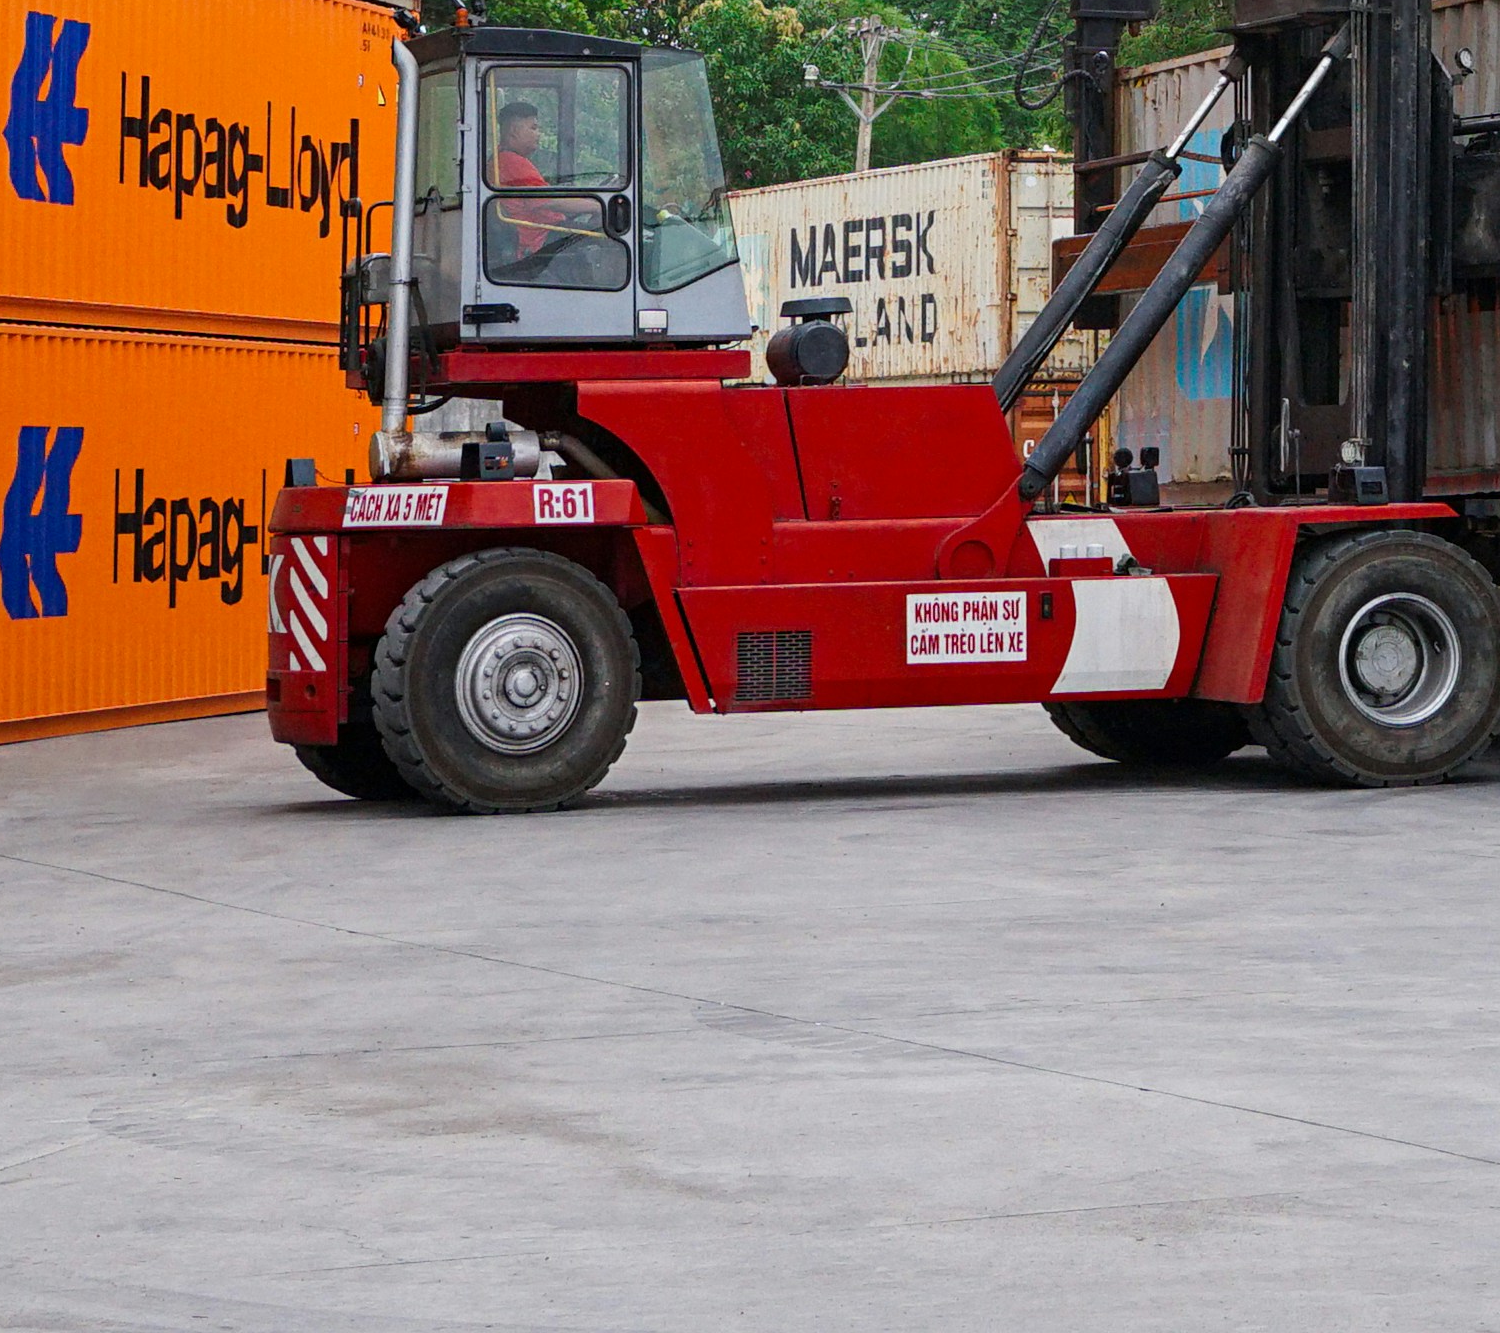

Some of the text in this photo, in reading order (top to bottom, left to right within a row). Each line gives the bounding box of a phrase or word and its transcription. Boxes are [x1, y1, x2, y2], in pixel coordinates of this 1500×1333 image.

[118, 70, 359, 239] Hapag-Lloyd
[790, 209, 936, 289] MAERSK
[350, 487, 443, 523] CÁCH XA 5 MÉT
[538, 488, 589, 519] R:61
[914, 595, 1021, 626] KHÔNG PHẬN SỰ
[979, 626, 1004, 654] LÊN
[1008, 631, 1024, 653] XE
